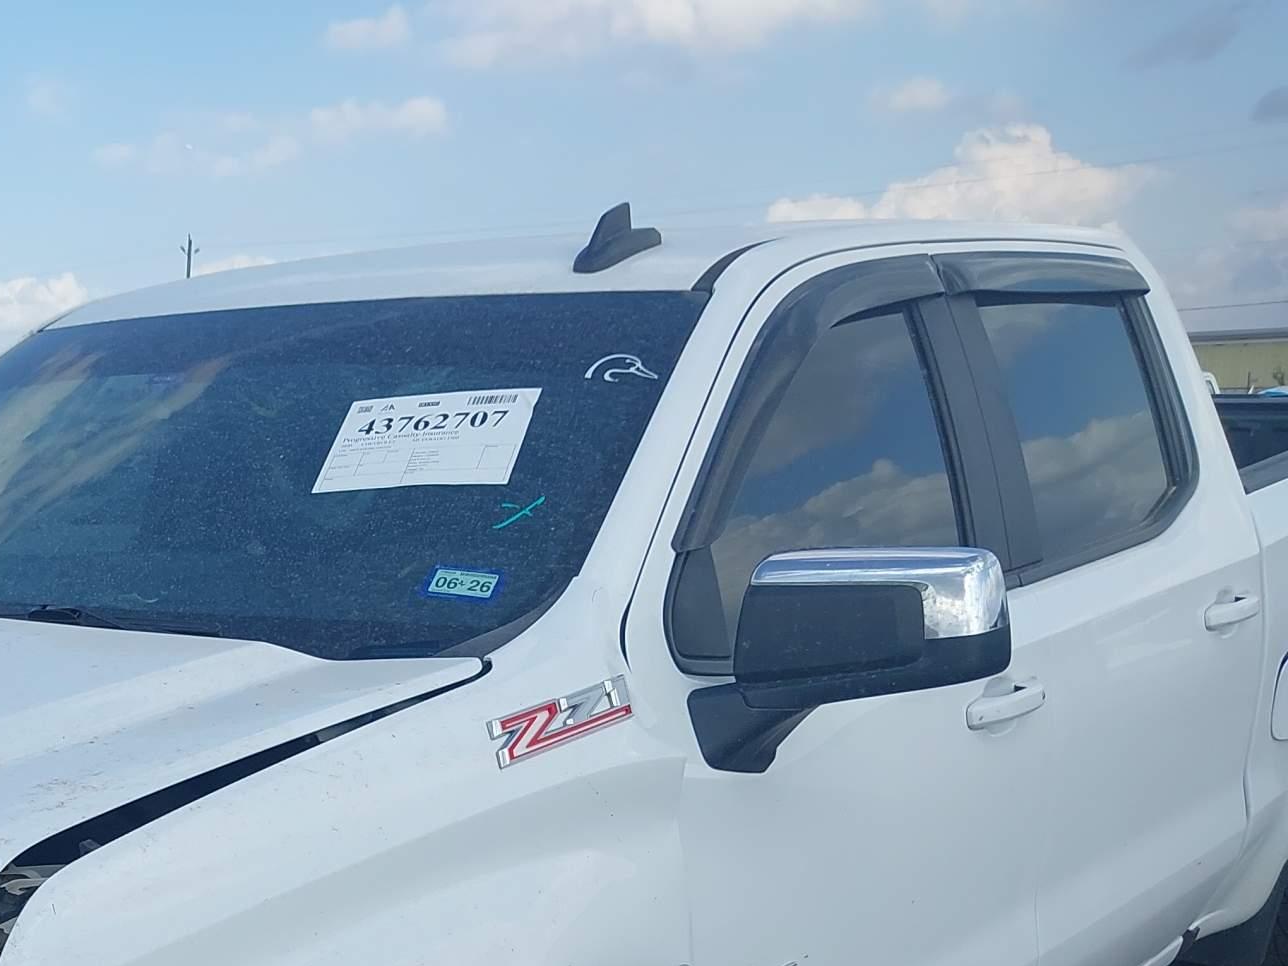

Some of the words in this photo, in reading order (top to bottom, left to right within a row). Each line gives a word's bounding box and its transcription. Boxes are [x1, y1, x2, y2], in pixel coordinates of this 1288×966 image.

[357, 409, 509, 436] 43762707
[435, 576, 459, 590] 06
[467, 579, 493, 593] 26
[486, 674, 633, 770] Z71
